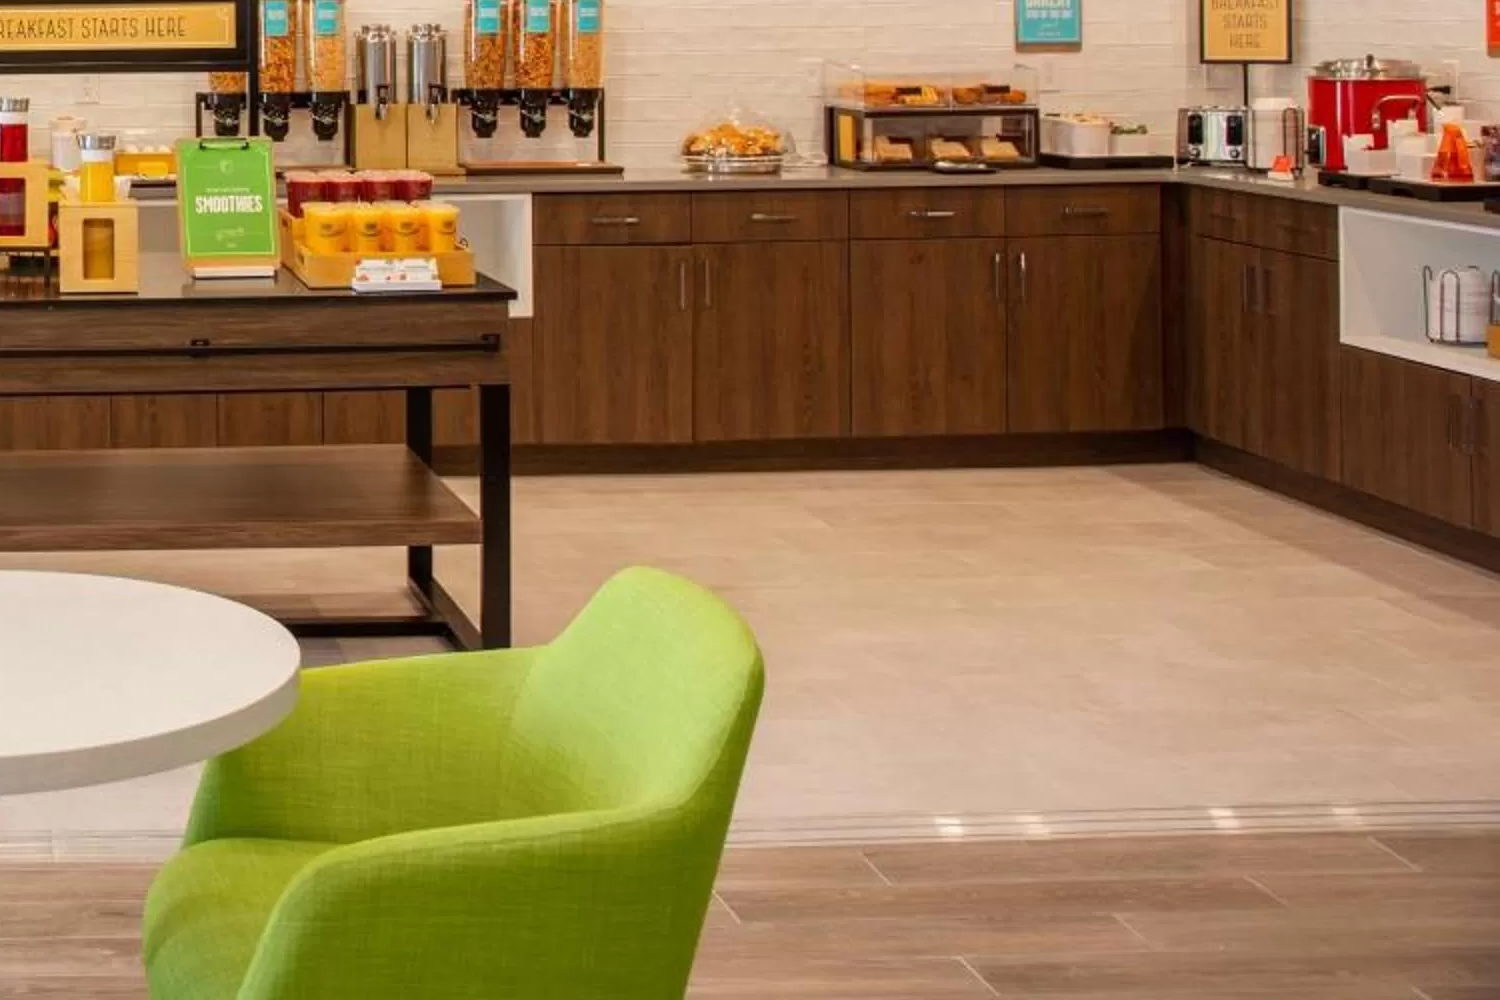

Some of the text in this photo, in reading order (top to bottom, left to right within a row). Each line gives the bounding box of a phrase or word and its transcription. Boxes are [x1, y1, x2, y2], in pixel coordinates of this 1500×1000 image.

[81, 16, 139, 38] STARTS
[145, 15, 187, 37] HERE
[1223, 13, 1268, 30] STARTS
[1229, 33, 1261, 49] HERE
[195, 195, 263, 214] SMOOTHIES
